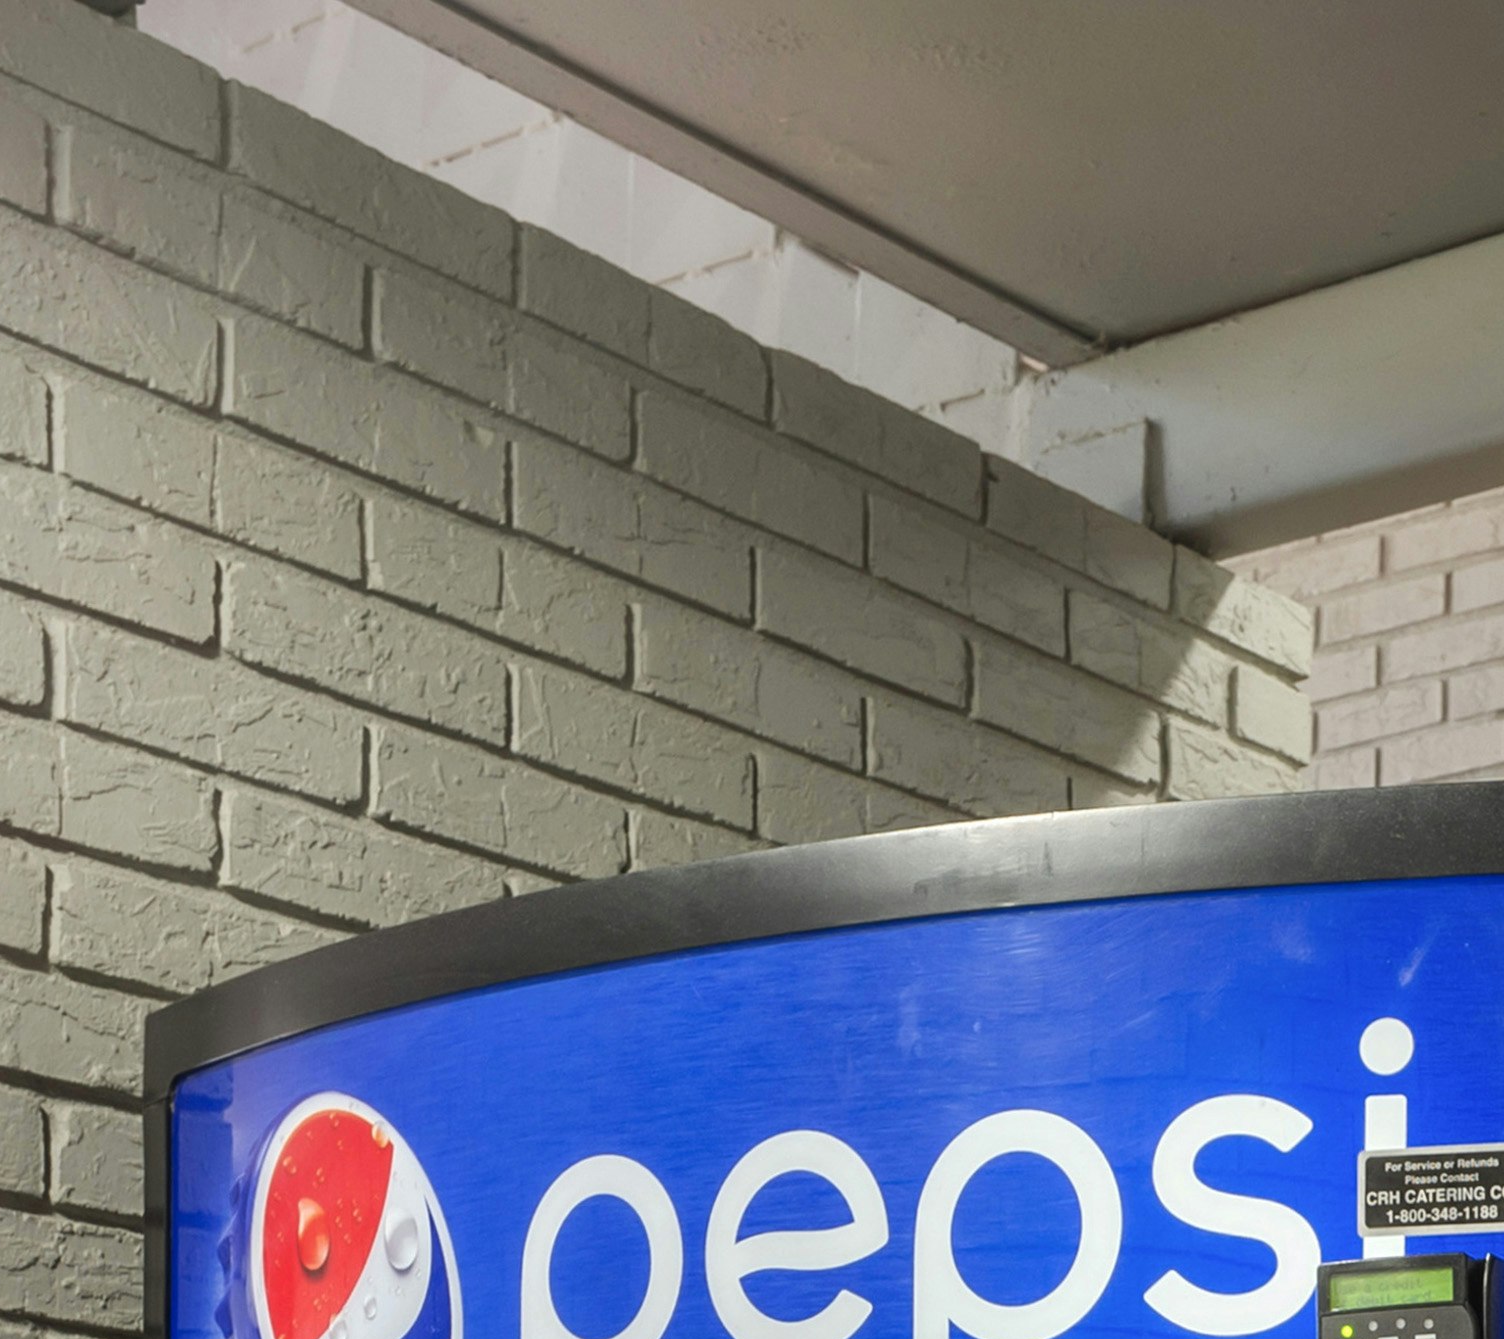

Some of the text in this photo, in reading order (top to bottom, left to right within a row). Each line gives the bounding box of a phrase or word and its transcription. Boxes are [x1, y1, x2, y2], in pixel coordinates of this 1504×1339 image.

[1385, 1158, 1499, 1171] For Service or Refunds
[1405, 1173, 1479, 1184] Please Contact
[1367, 1191, 1400, 1205] CRH
[1405, 1187, 1485, 1203] CATERING
[1386, 1205, 1498, 1223] 1-800-348-1188
